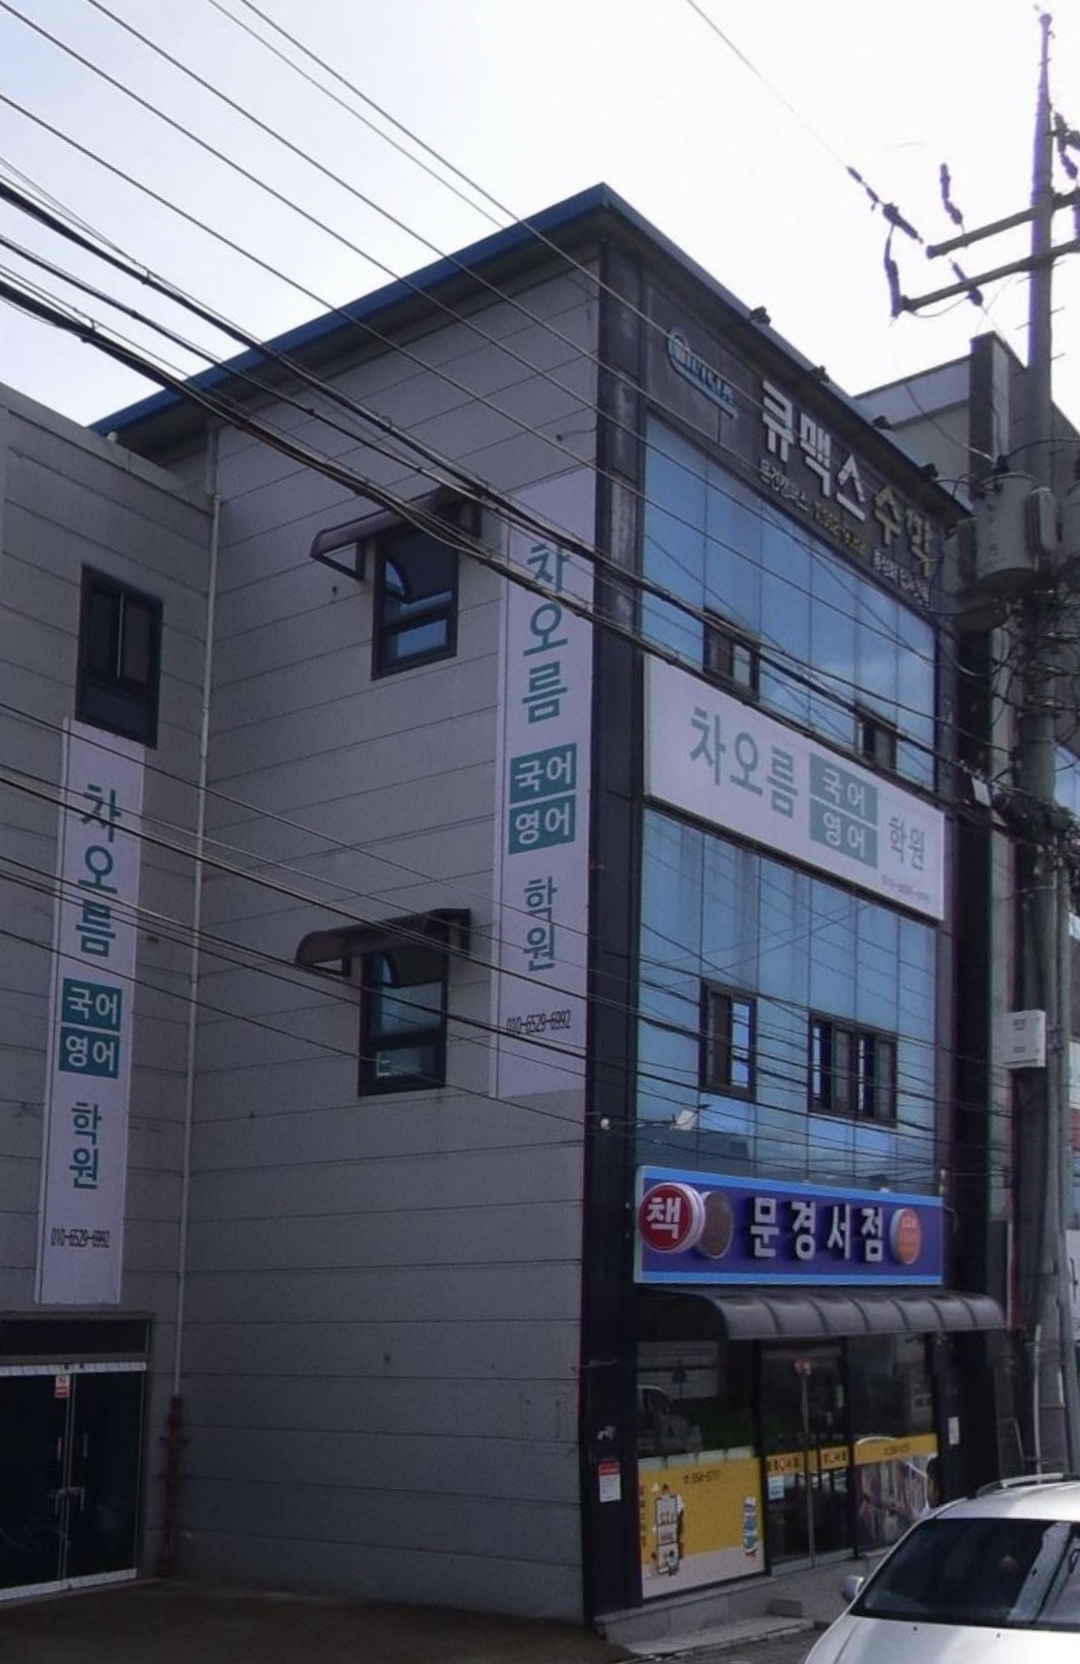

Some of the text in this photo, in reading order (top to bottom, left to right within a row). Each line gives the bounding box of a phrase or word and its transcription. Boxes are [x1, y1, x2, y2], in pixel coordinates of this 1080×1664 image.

[521, 543, 570, 724] 차오름
[515, 751, 572, 792] 국어
[690, 706, 798, 818] 차오름
[821, 767, 865, 817] 국어
[515, 802, 571, 845] 영어
[823, 811, 865, 859] 영어
[889, 816, 924, 872] 학원
[75, 783, 122, 958] 차오름
[523, 876, 558, 972] 학원
[67, 986, 118, 1025] 국어
[66, 1035, 115, 1072] 영어
[69, 1102, 102, 1189] 학원
[647, 1196, 681, 1239] 책
[751, 1197, 883, 1262] 문경서점
